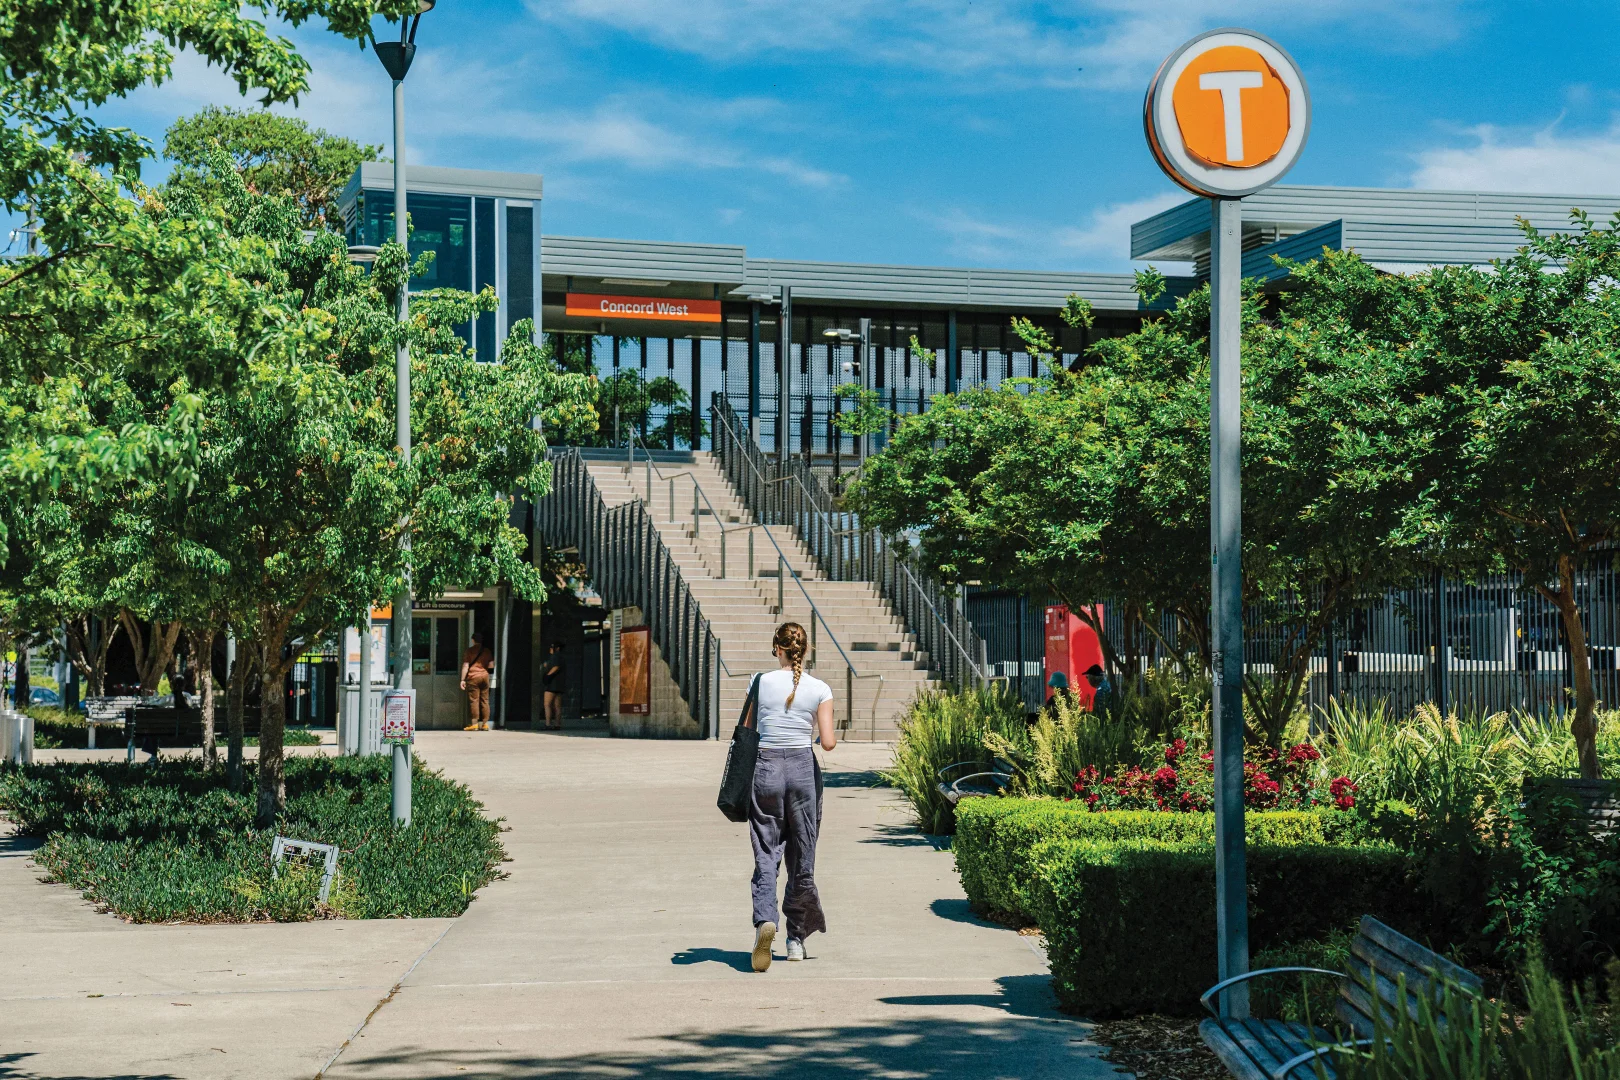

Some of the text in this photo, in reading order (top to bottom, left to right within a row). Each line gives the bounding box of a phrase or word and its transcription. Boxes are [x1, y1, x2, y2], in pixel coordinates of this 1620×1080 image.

[1199, 70, 1263, 161] T
[600, 299, 689, 316] Concord West
